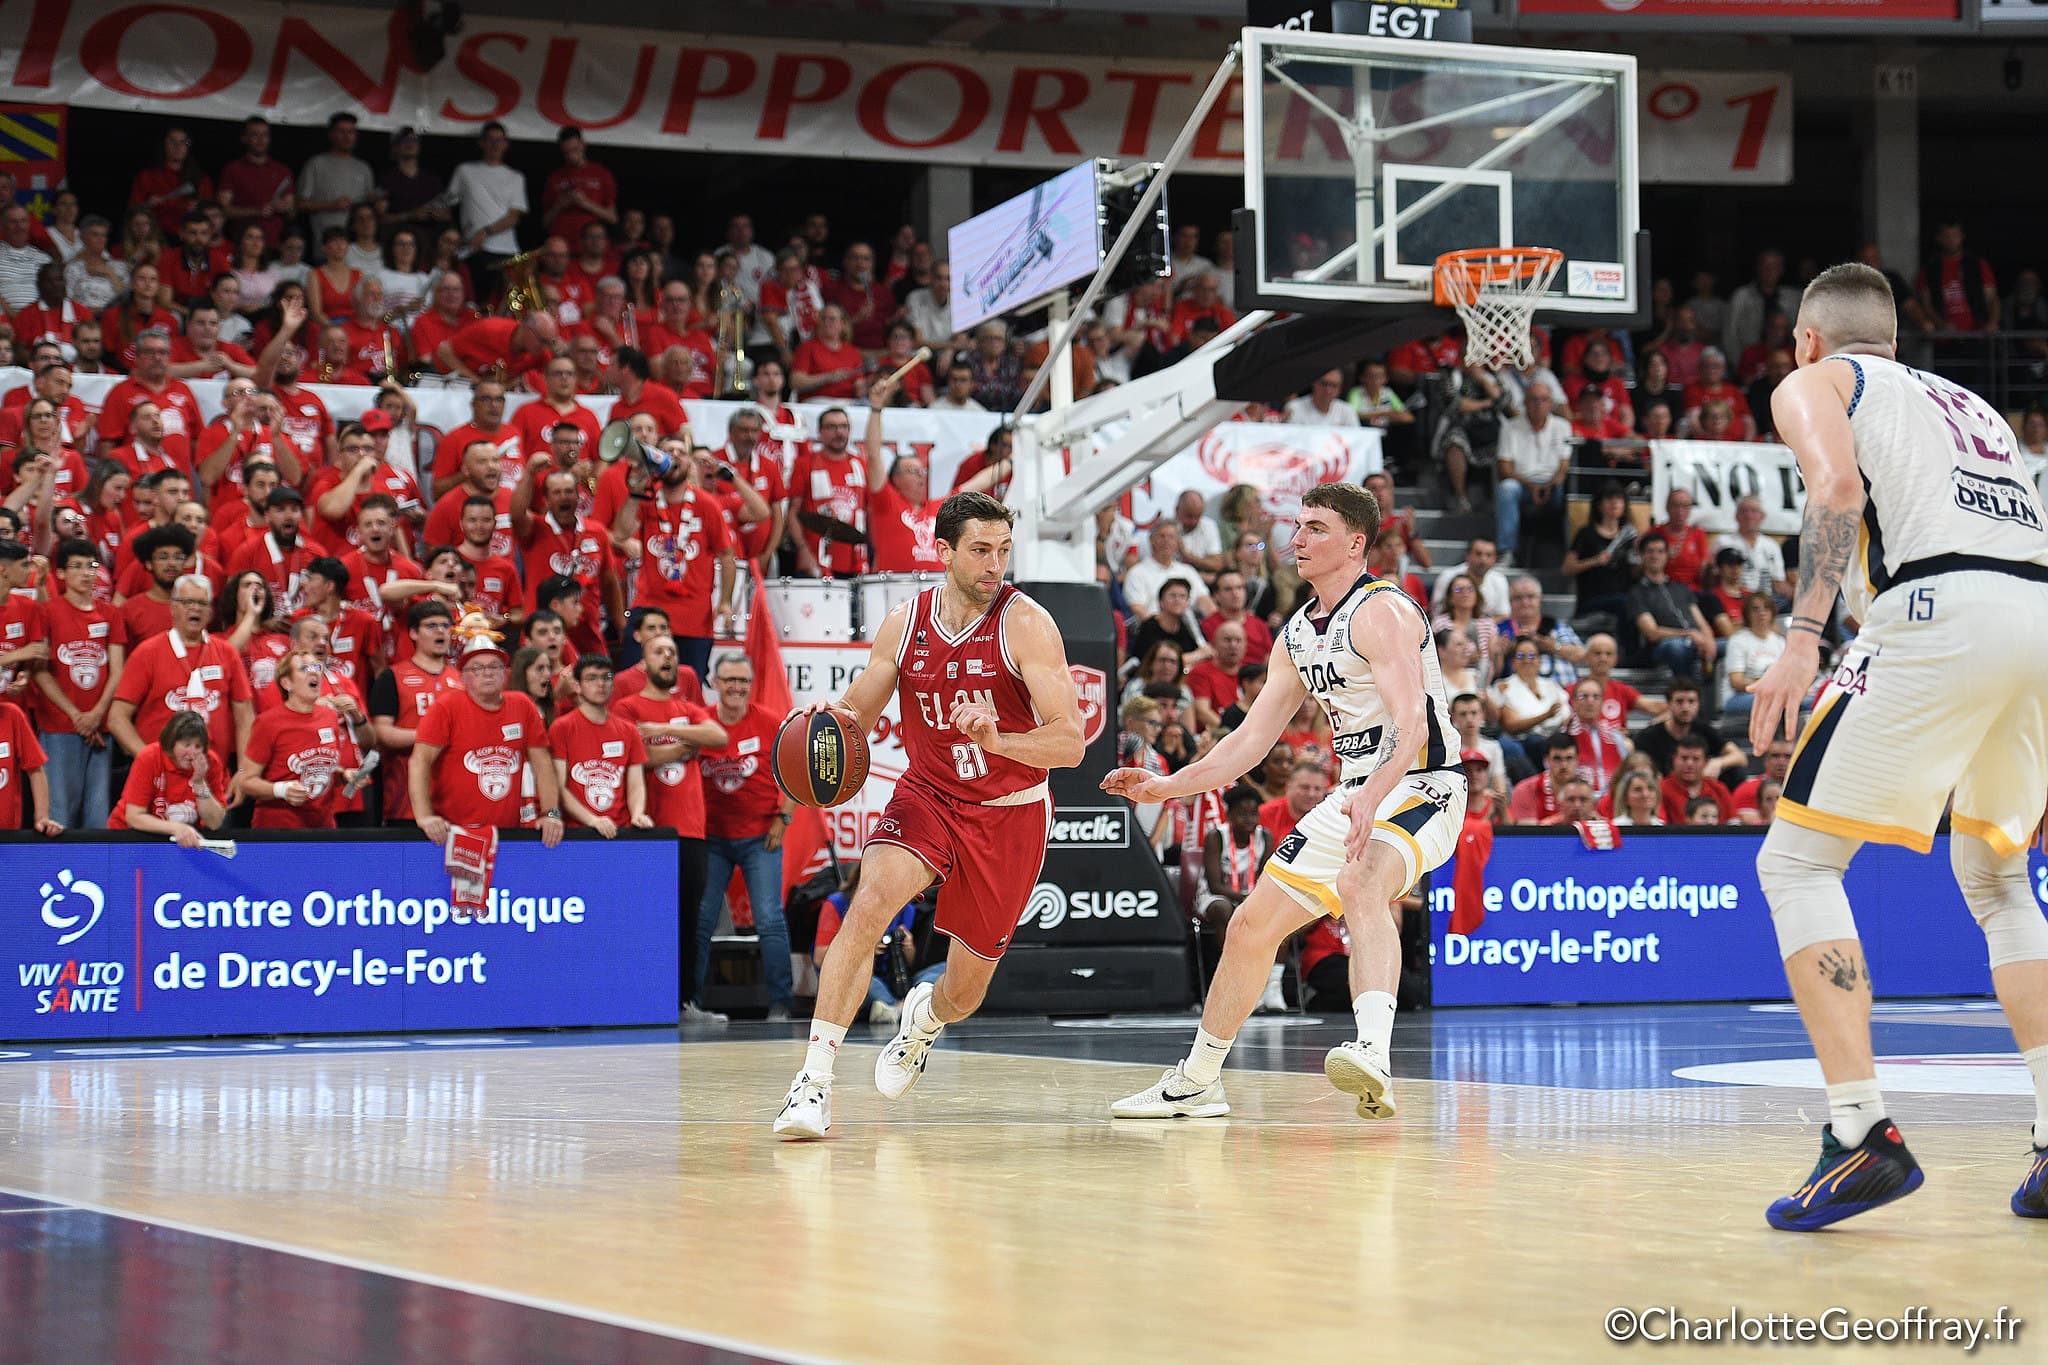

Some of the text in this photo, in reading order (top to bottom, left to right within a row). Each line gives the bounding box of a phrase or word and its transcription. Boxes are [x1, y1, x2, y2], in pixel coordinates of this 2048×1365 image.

[1272, 10, 1315, 33] GT
[1368, 6, 1440, 40] EGT
[1957, 482, 2039, 525] DELIN
[1908, 587, 1936, 622] 15
[1299, 661, 1348, 694] JDA
[1836, 664, 1867, 696] DA
[824, 726, 838, 785] LEGACY
[951, 742, 988, 780] 21
[1047, 814, 1122, 841] etclic
[153, 892, 291, 928] Centre
[1070, 890, 1159, 919] suez
[1511, 877, 1738, 918] Orthopédique
[1445, 930, 1660, 973] Dracy-le-Fort
[18, 960, 124, 987] VIVALTO
[153, 949, 487, 997] de Dracy-le-Fort
